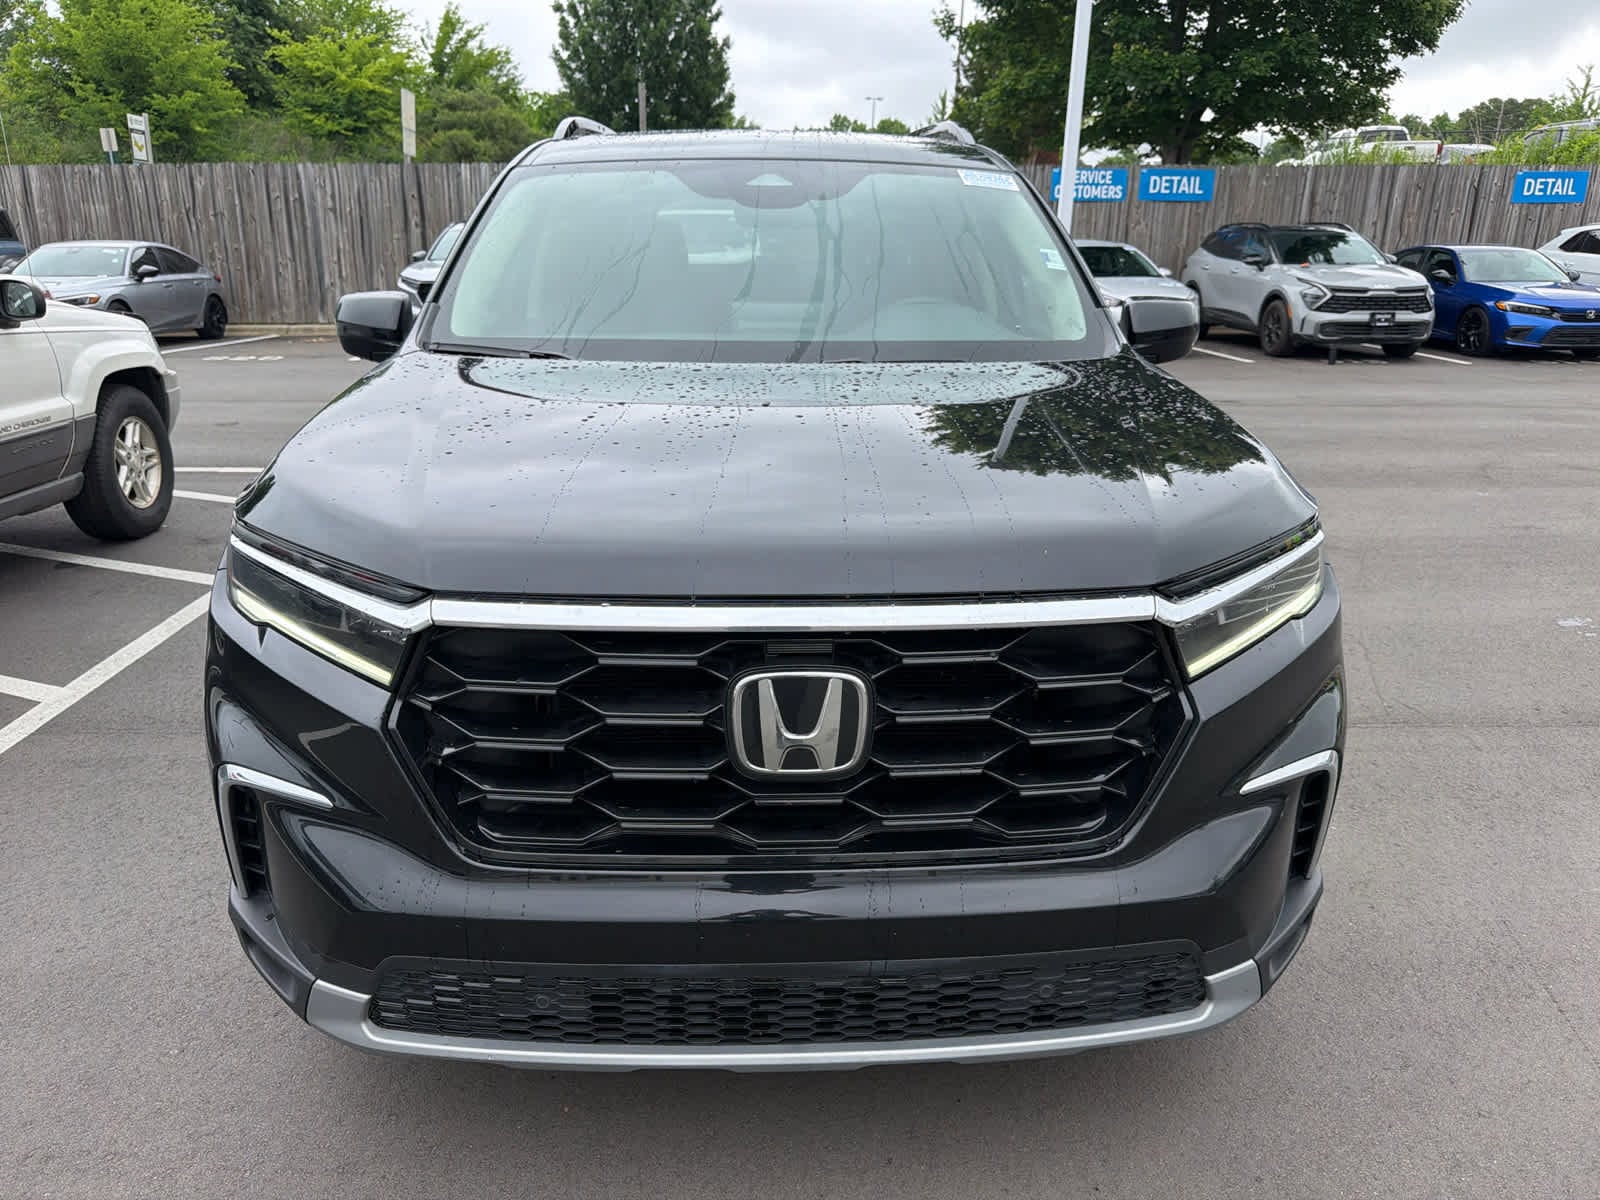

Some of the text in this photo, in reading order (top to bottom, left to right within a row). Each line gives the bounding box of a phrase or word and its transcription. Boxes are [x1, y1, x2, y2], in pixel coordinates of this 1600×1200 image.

[1072, 170, 1113, 185] ERVICE
[1149, 175, 1204, 194] DETAIL
[1522, 177, 1577, 196] DETAIL
